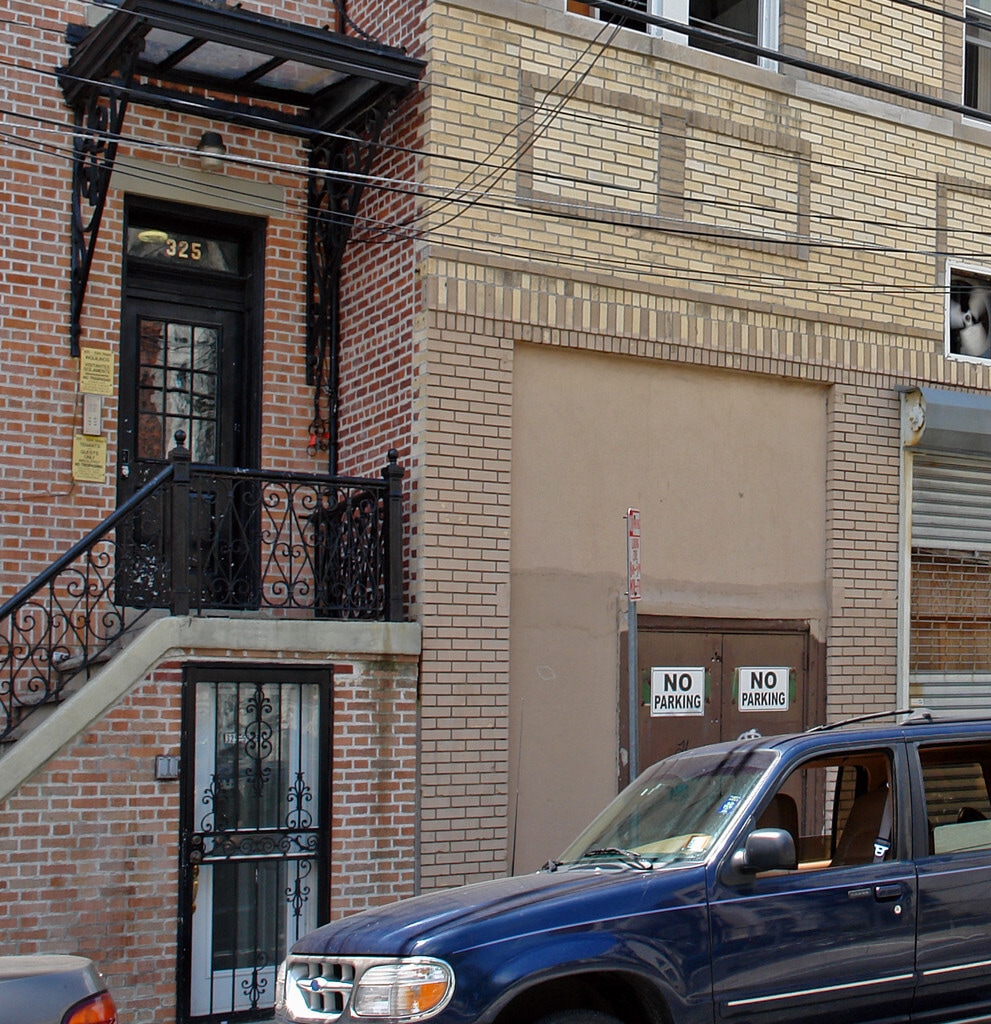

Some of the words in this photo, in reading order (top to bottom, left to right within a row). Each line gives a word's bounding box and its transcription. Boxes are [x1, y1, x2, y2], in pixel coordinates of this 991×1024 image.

[166, 238, 202, 260] 325
[664, 673, 692, 692] NO
[750, 671, 777, 690] NO
[654, 694, 701, 710] PARKING
[741, 692, 786, 707] PARKING
